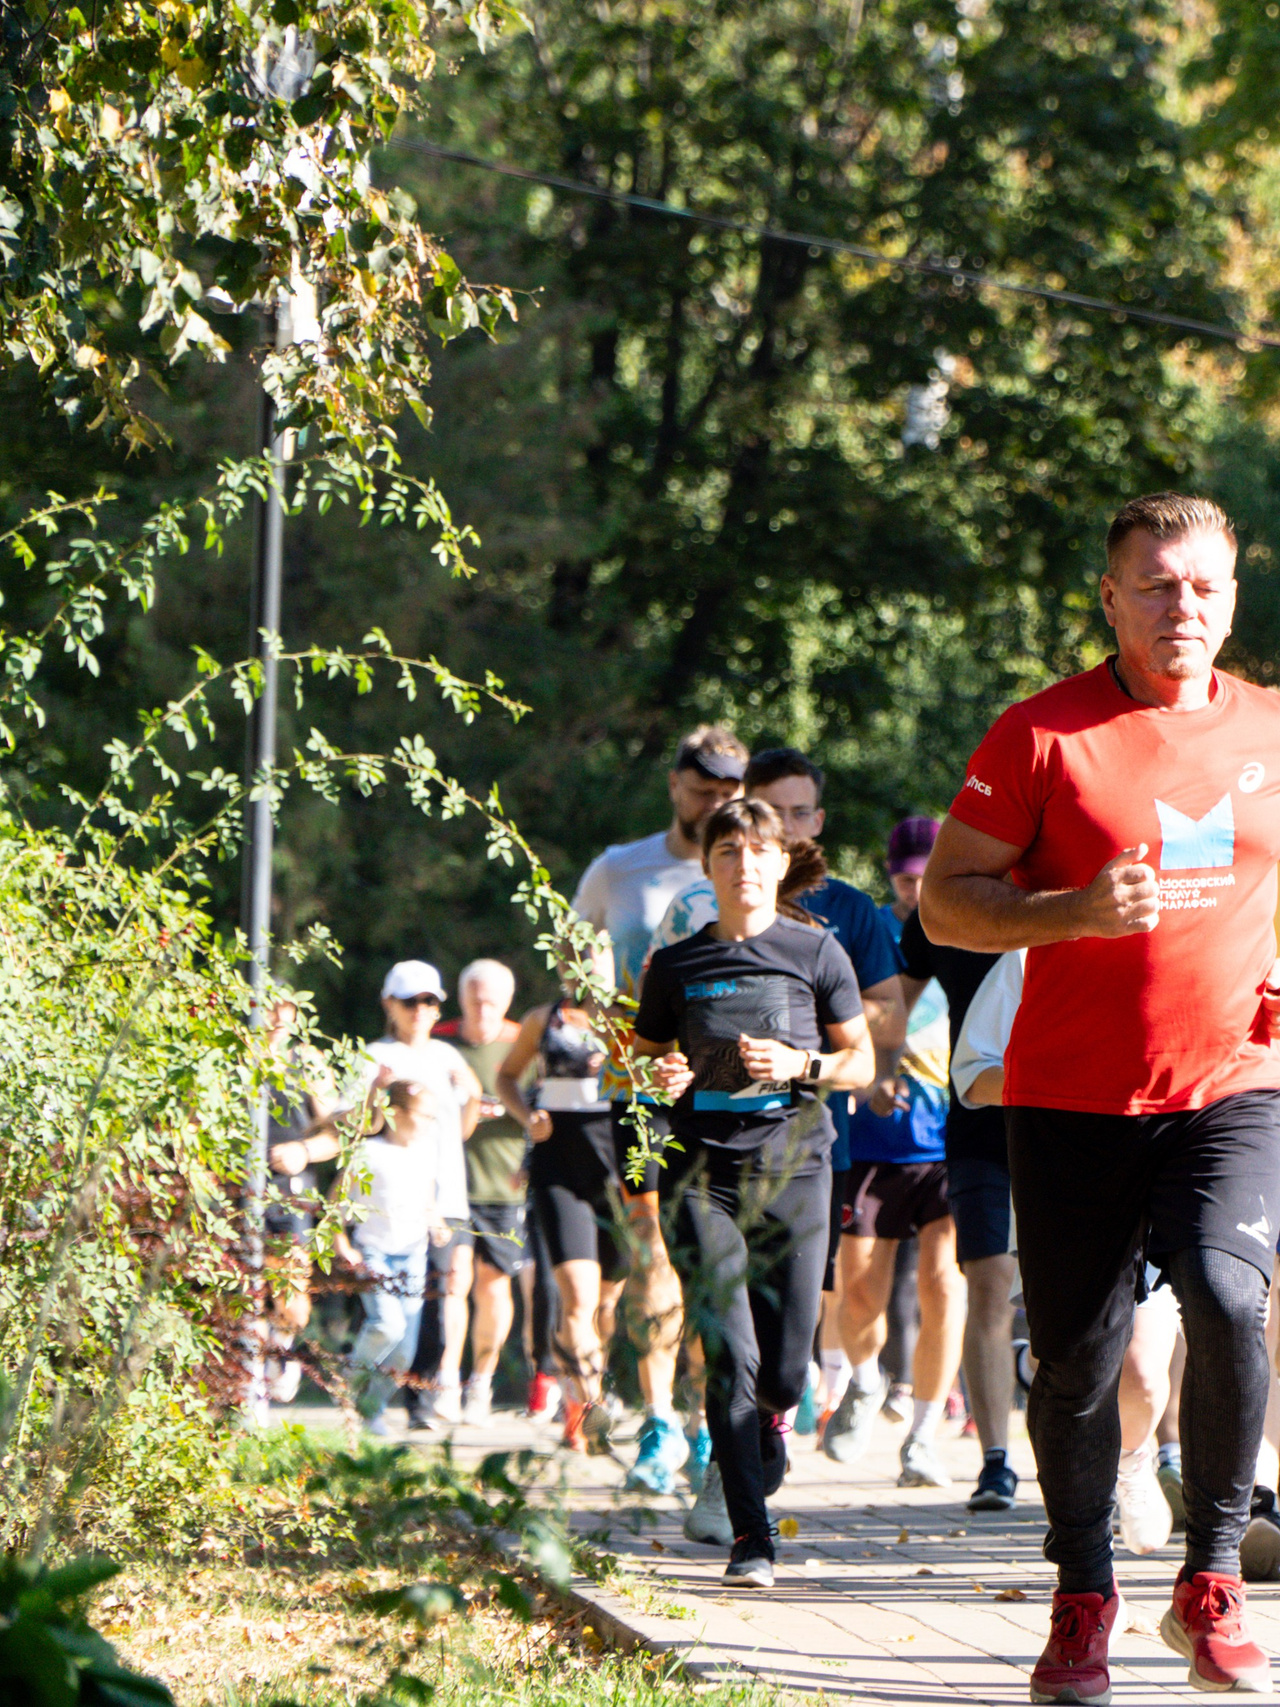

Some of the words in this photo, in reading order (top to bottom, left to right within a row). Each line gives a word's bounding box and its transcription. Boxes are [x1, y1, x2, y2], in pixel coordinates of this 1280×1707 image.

[1159, 873, 1236, 889] МОСКОВСКИЙ
[1160, 889, 1191, 900] ПОЛУ
[1160, 897, 1217, 910] МАРАФОН
[685, 980, 736, 1000] RUN
[758, 1081, 789, 1095] FILA
